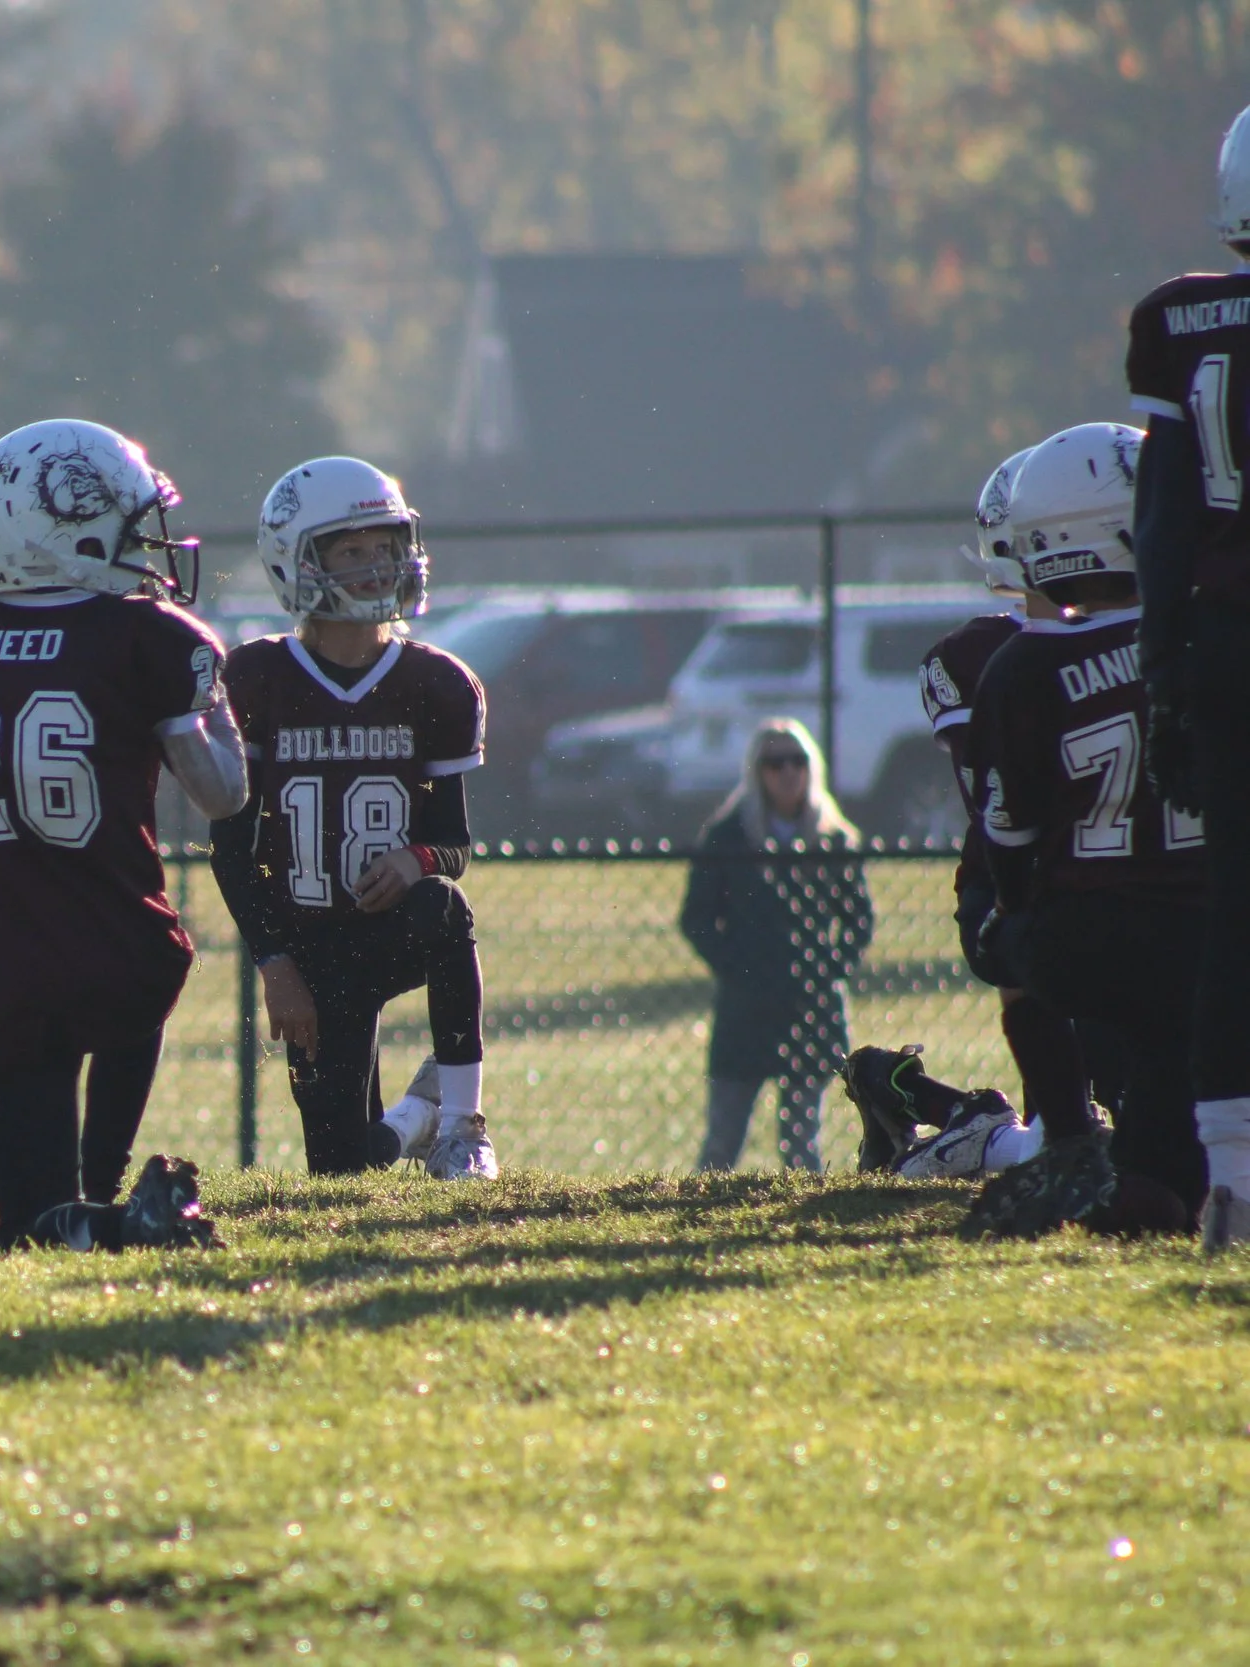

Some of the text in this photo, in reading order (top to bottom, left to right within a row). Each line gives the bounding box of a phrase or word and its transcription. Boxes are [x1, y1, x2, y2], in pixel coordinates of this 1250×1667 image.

[1189, 354, 1243, 512] 1
[1036, 554, 1096, 579] schutt
[276, 726, 415, 762] BULLDOGS
[280, 775, 411, 908] 18
